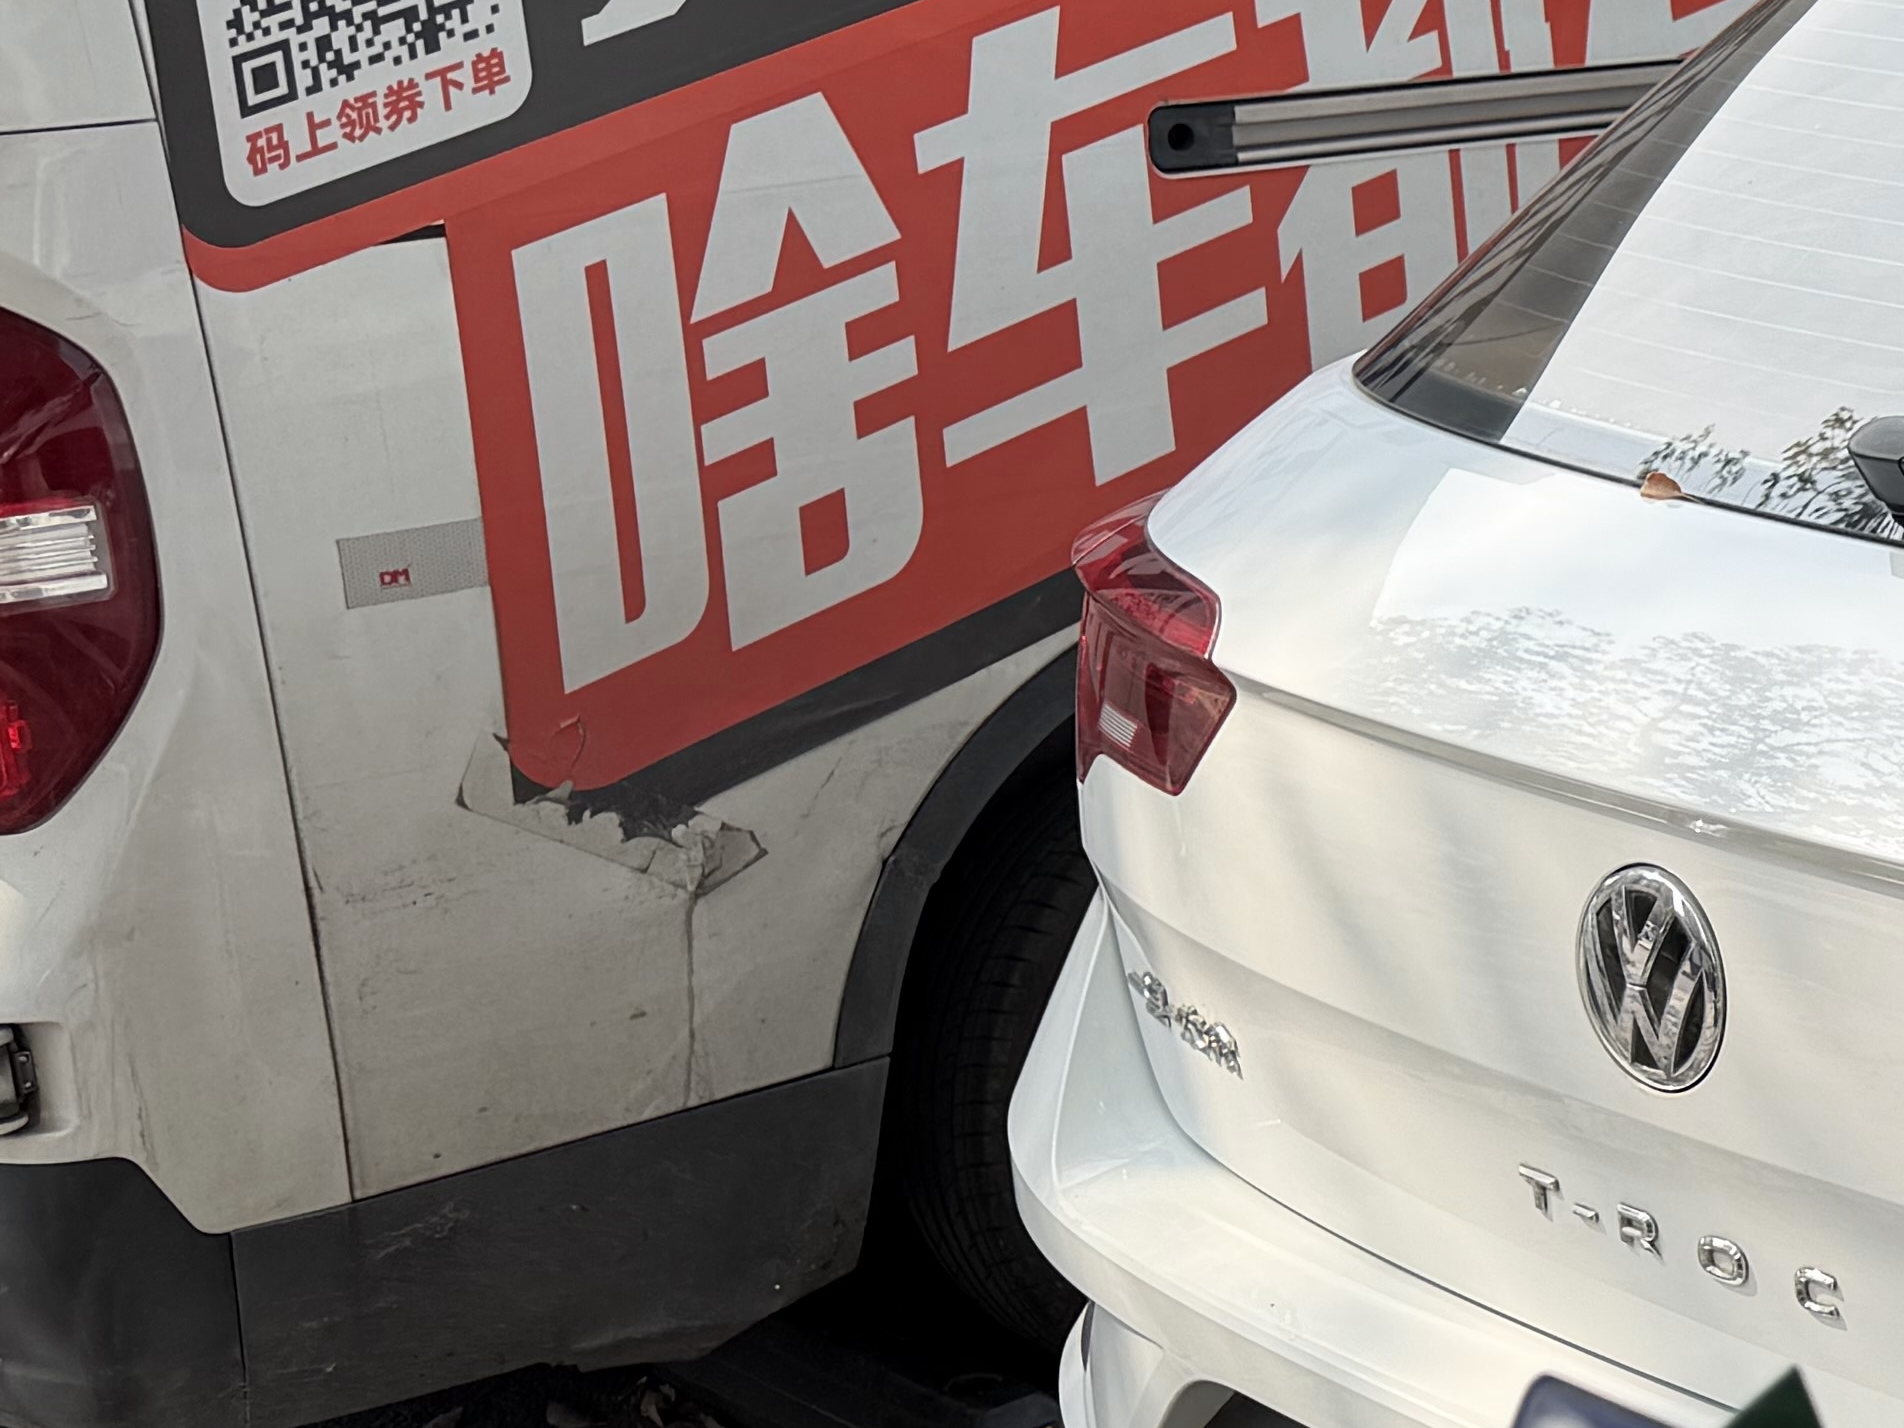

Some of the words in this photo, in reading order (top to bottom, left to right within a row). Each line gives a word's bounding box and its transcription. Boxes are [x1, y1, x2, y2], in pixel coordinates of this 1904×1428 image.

[246, 47, 512, 177] 码上领券下单
